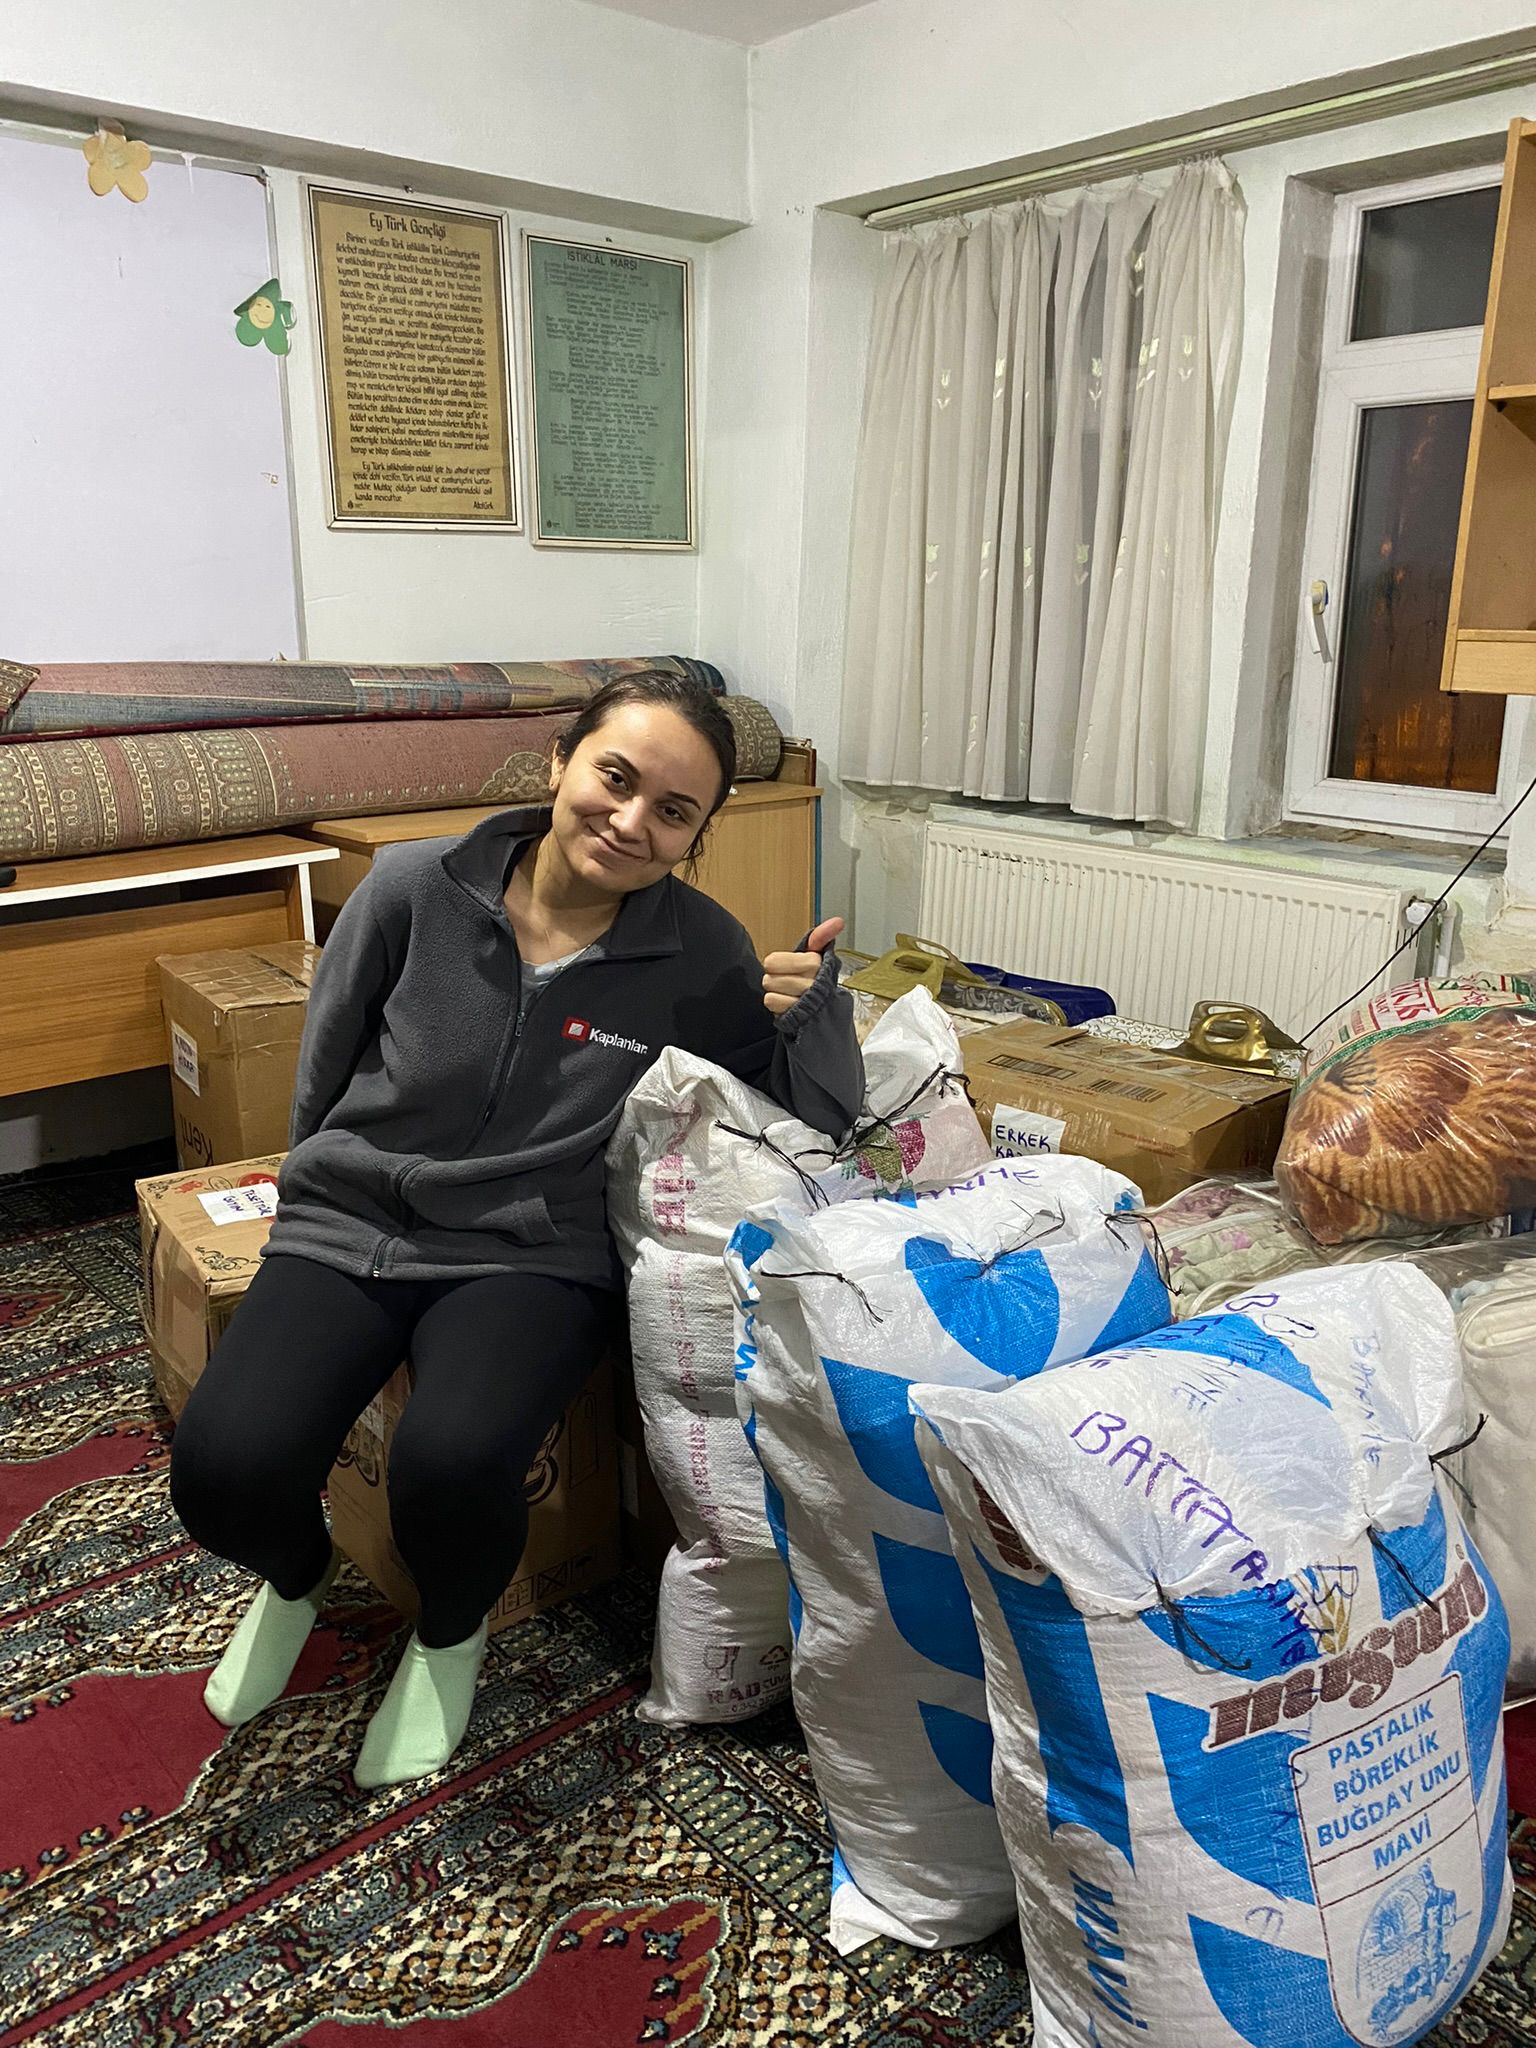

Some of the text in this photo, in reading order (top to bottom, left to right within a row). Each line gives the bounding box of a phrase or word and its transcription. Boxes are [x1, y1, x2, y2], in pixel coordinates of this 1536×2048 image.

[369, 212, 447, 241] Ey Türk Gençliği
[995, 1125, 1051, 1152] ERKEK
[1317, 1750, 1462, 1848] BUĞDAY UNU
[1334, 1730, 1441, 1803] BÖREKLİK
[1372, 1812, 1433, 1871] MAVİ
[1068, 1869, 1149, 2030] MAVİ
